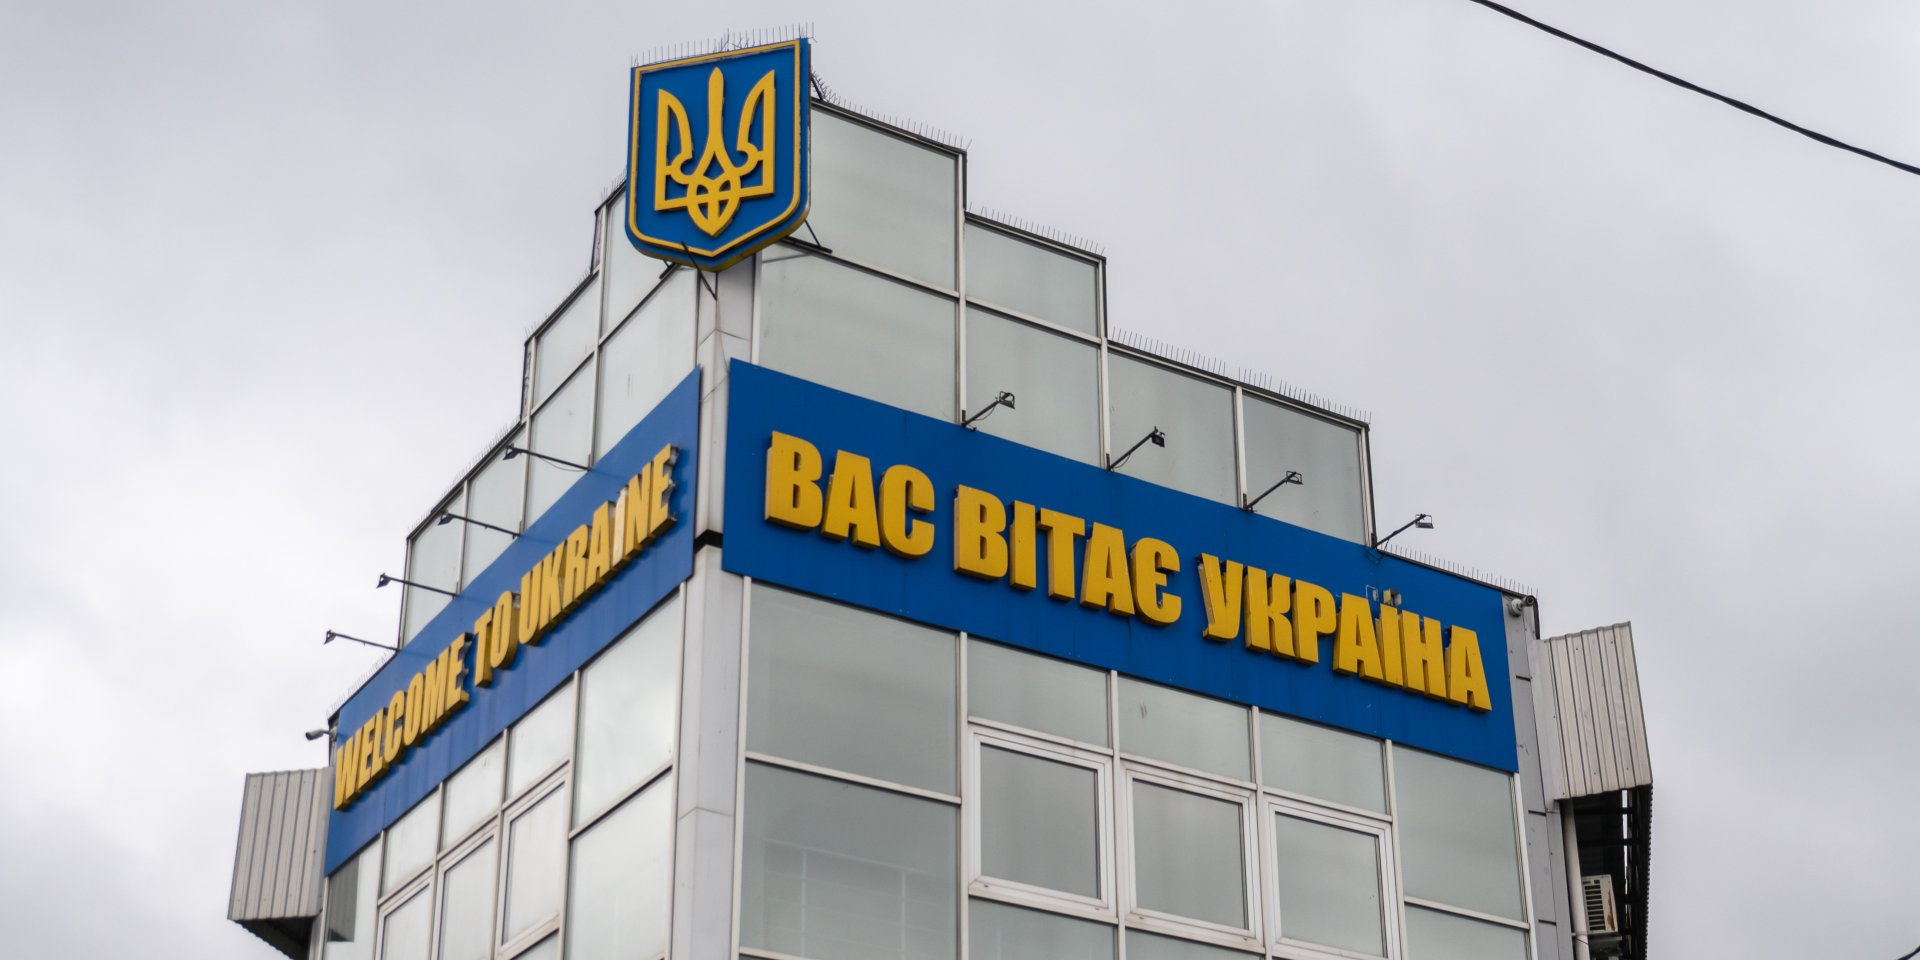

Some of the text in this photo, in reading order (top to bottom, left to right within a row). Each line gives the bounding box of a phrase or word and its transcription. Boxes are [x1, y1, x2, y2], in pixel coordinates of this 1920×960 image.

[334, 443, 679, 811] WELCOME TO UKRAINE
[765, 431, 1492, 713] ВАС ВІТАЄ УКРАЇНА
